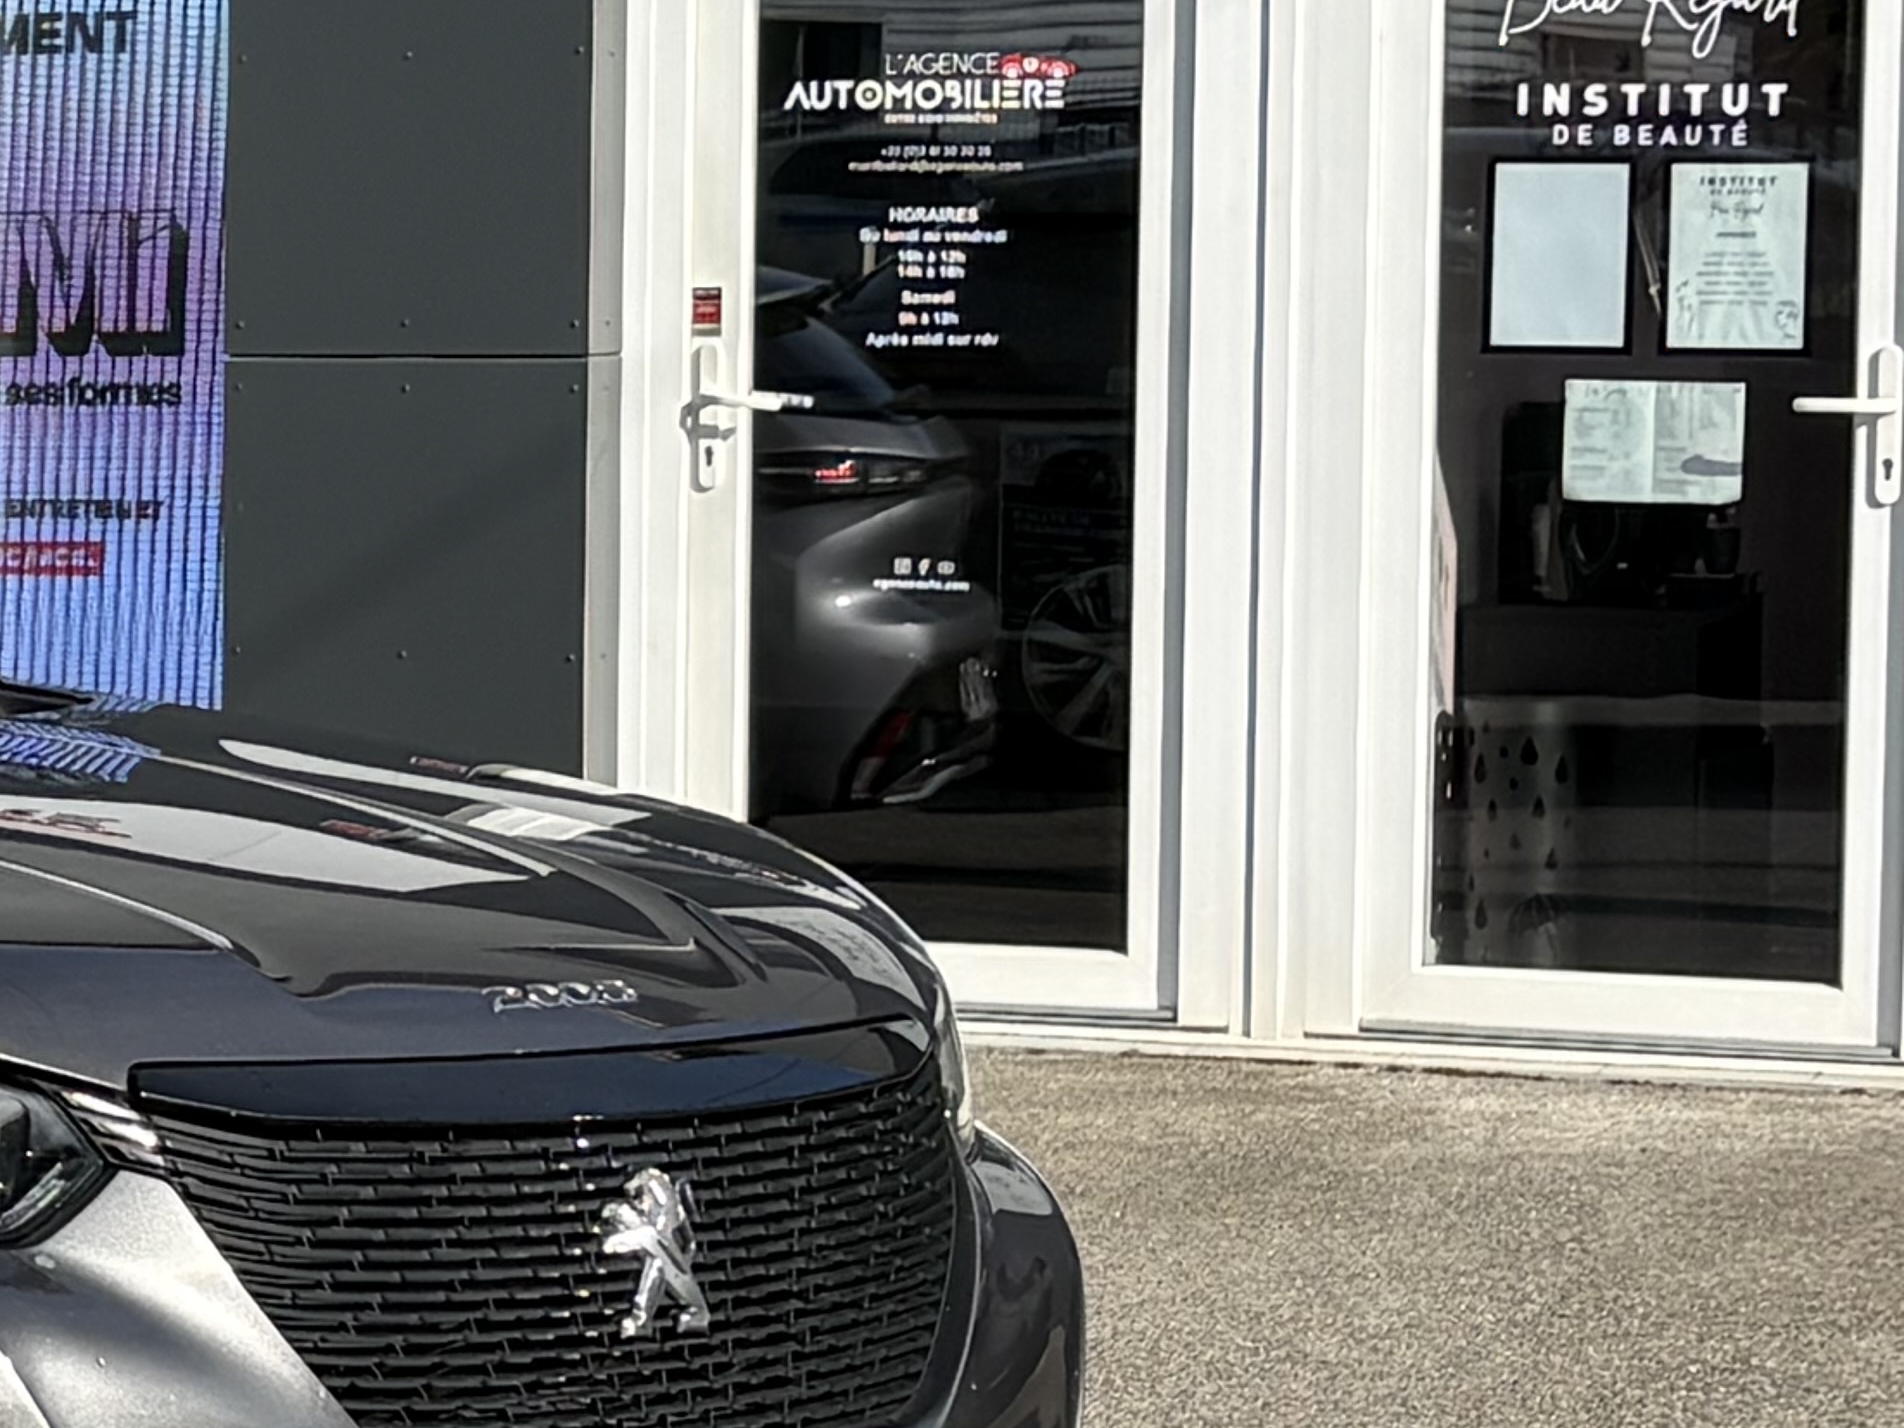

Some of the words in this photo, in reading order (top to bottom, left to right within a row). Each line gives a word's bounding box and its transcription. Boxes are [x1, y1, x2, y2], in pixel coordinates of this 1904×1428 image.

[885, 52, 1000, 76] L'AGENCE
[1517, 82, 1788, 117] INSTITUT
[1552, 124, 1593, 146] DE
[889, 206, 979, 223] HORAIRES
[944, 229, 1008, 243] vendredi
[901, 289, 956, 305] Samedi
